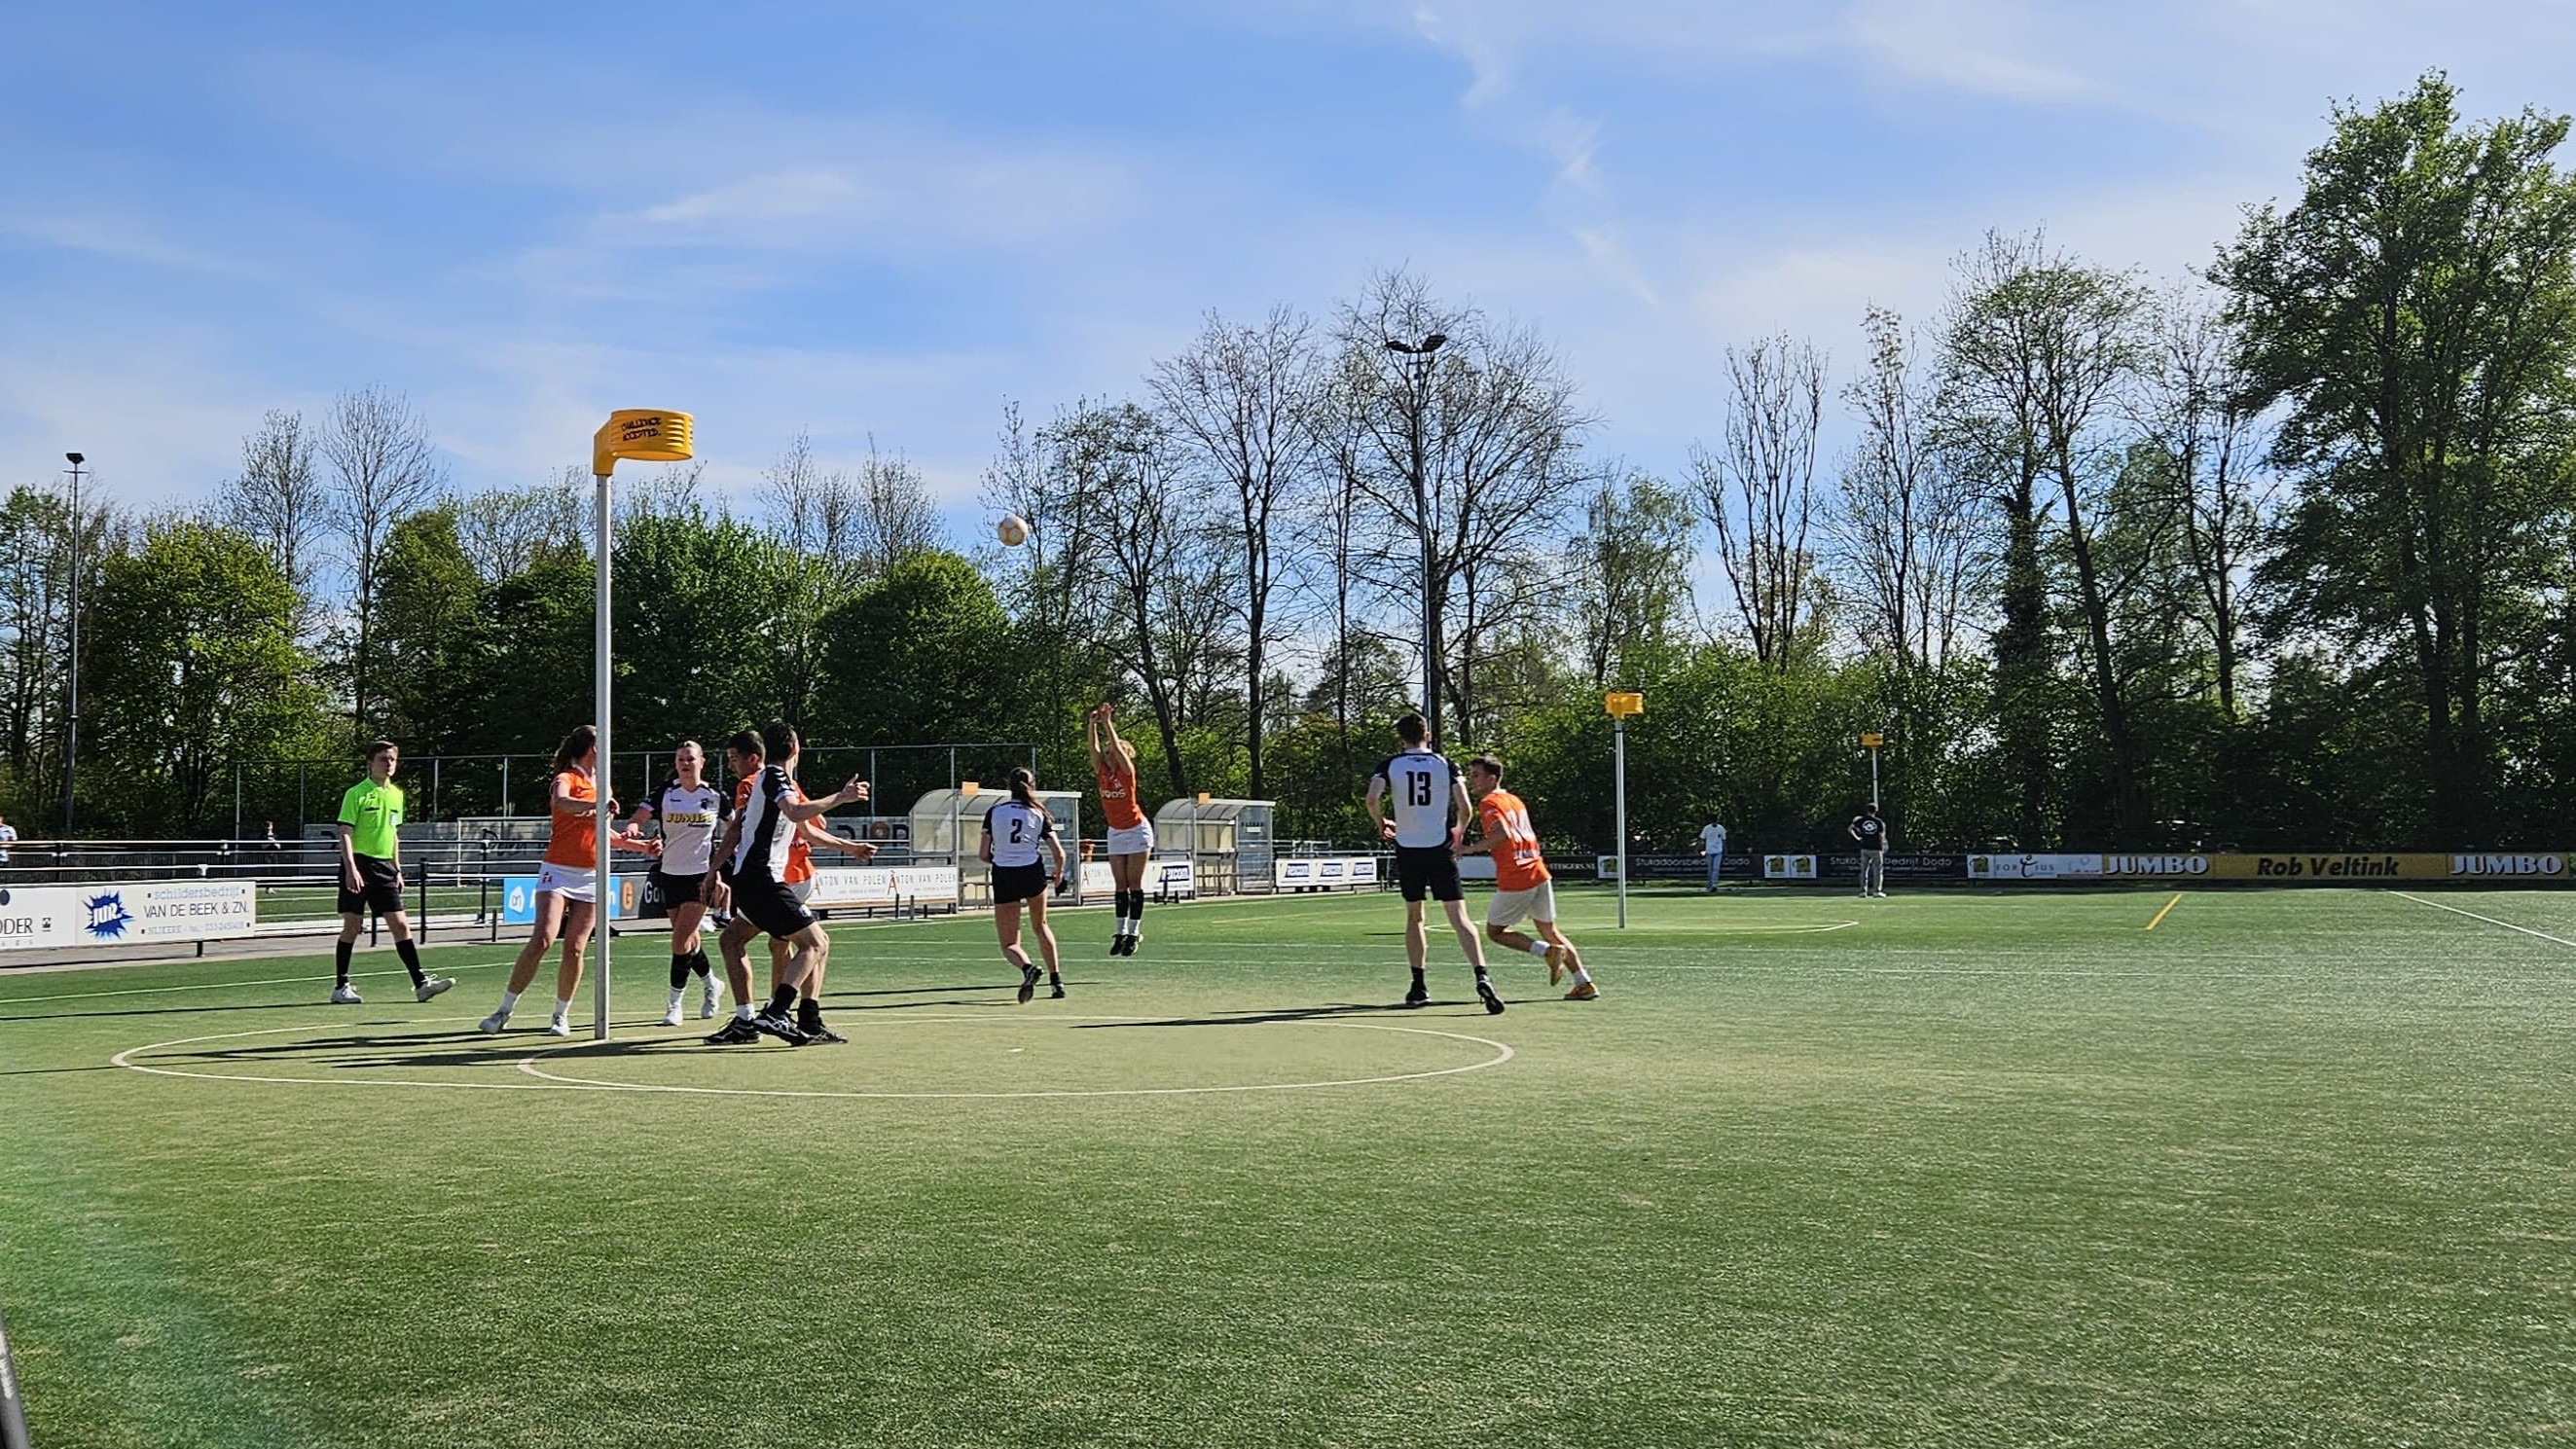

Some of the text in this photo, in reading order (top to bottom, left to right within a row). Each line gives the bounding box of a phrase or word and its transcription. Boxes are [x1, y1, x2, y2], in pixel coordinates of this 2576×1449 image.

[1406, 770, 1432, 807] 13
[1009, 817, 1023, 844] 2
[1922, 857, 1953, 866] Dodo
[2104, 855, 2208, 875] JUMBO
[2257, 856, 2400, 876] Rob Veltink
[2449, 854, 2564, 875] JUMBO
[844, 876, 859, 886] VAN
[919, 874, 931, 883] VAN
[153, 887, 241, 900] schildersbedrijf
[144, 900, 249, 918] VAN DE BEEK & ZN.
[0, 917, 33, 935] DER
